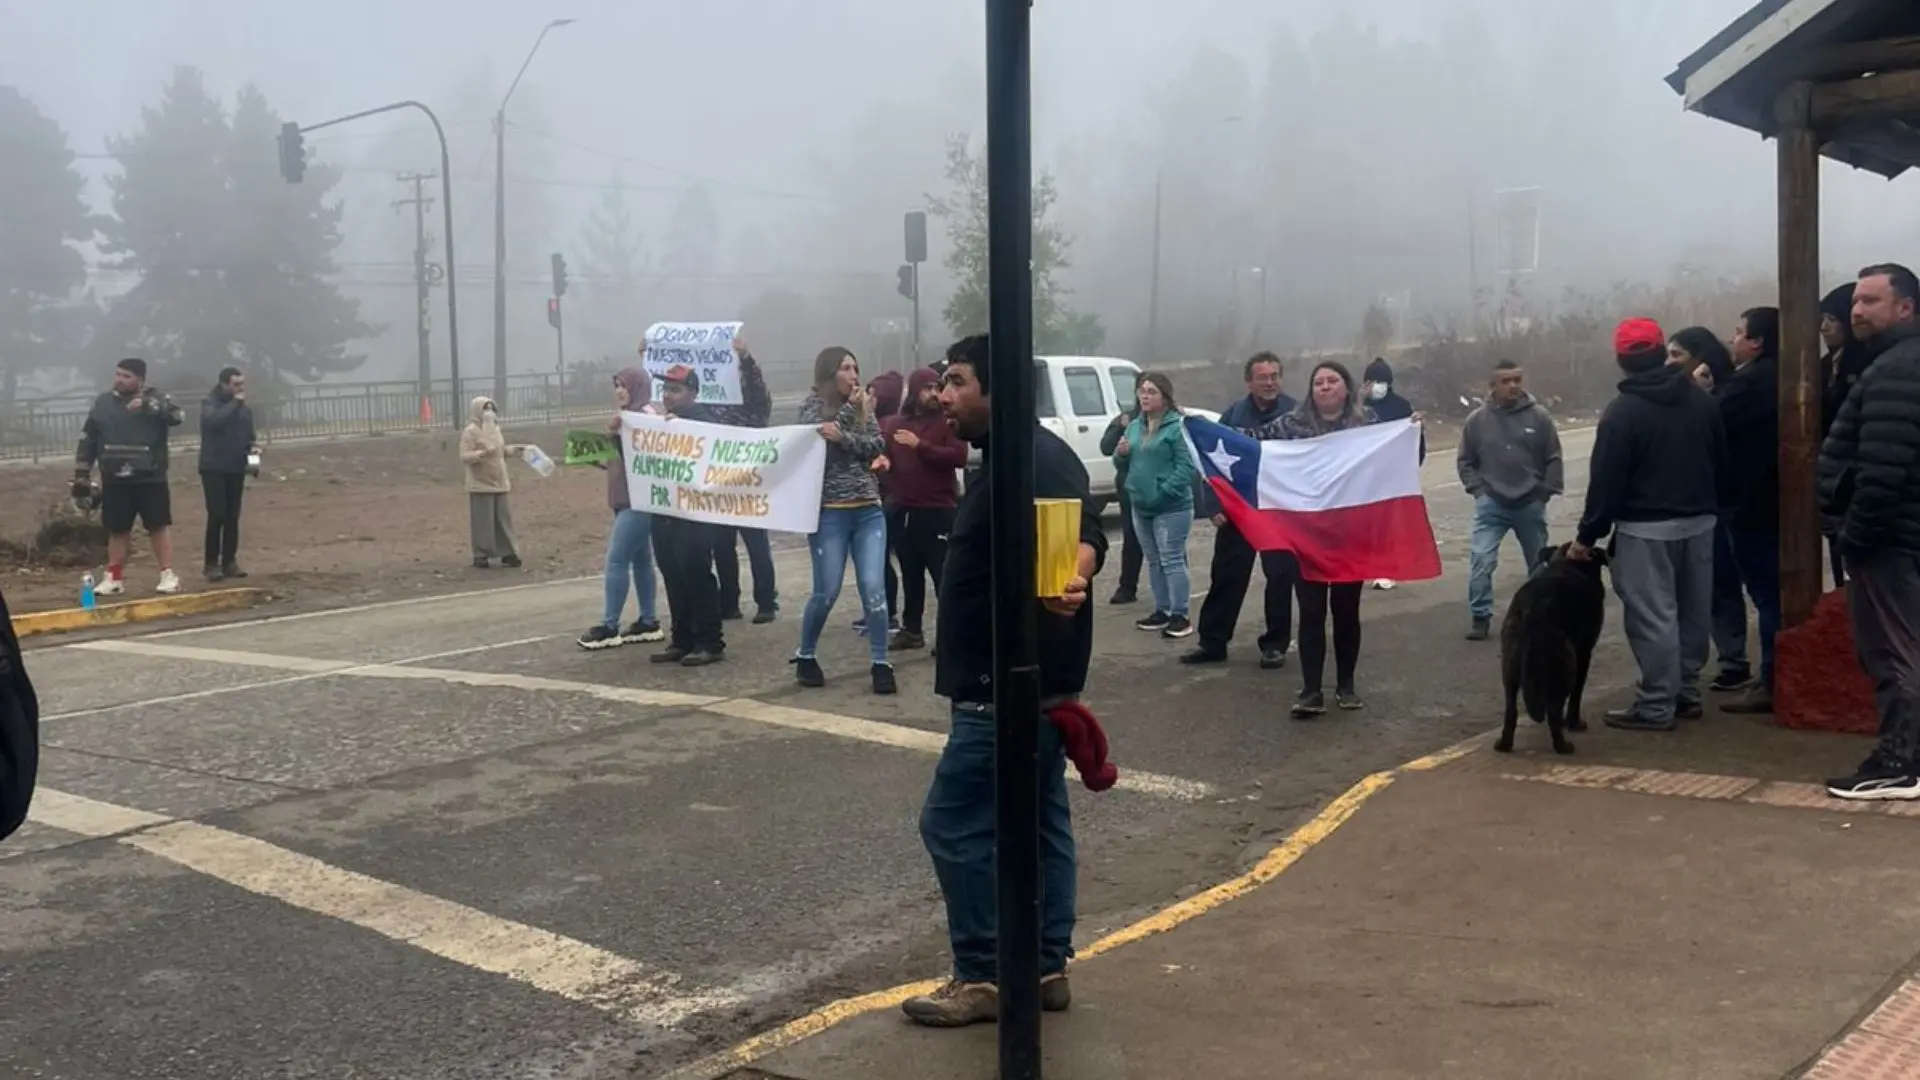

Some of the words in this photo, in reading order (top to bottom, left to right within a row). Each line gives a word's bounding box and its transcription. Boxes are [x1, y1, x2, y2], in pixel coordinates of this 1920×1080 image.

[695, 347, 733, 365] VECINOS
[703, 368, 717, 382] DE
[632, 428, 706, 459] EXIGIMOS
[711, 437, 779, 464] NUESTROS
[632, 453, 696, 483] ALIMENTOS
[651, 483, 671, 507] POR
[676, 486, 769, 516] PARTICULARES
